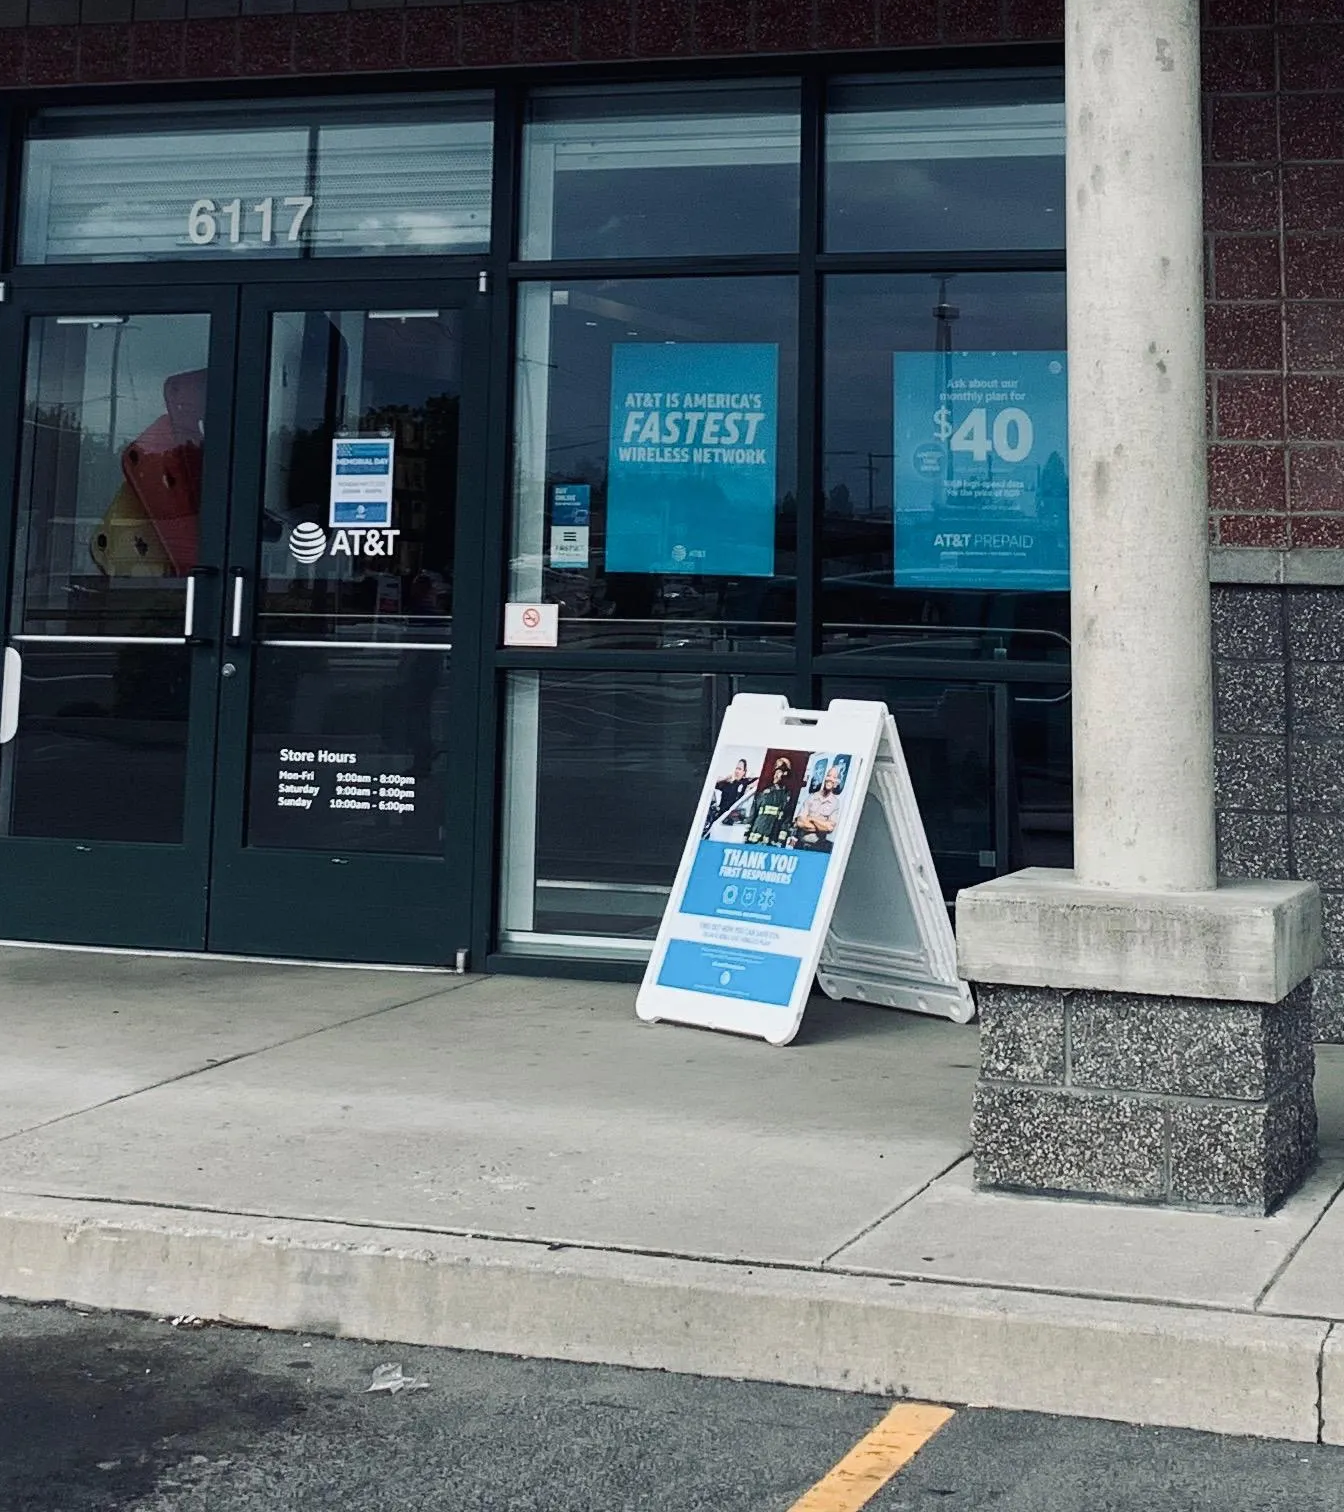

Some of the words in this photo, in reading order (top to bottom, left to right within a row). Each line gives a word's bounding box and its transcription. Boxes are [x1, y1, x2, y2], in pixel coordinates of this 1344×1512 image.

[188, 196, 313, 244] 6117
[946, 379, 967, 389] Ask
[969, 379, 998, 389] about
[625, 392, 663, 408] AT&T
[666, 392, 680, 408] IS
[683, 392, 762, 409] AMERICA'S
[939, 392, 983, 403] monthly
[985, 392, 1009, 403] plan
[1010, 391, 1027, 401] for
[623, 410, 765, 445] FASTEST
[933, 405, 1034, 462] $40
[619, 446, 689, 463] WIRELESS
[693, 447, 767, 465] NETWORK
[330, 529, 401, 556] AT&T
[933, 534, 973, 547] AT&T
[974, 534, 1034, 548] PREPAID
[280, 749, 314, 762] Store
[318, 750, 357, 763] Hours
[279, 771, 314, 780] Mon-Fri
[336, 773, 371, 783] 9:00am
[278, 783, 320, 796] Saturday
[278, 796, 312, 809] Sunday
[722, 848, 769, 871] THANK
[769, 853, 798, 873] YOU
[719, 865, 741, 877] FIRST
[741, 868, 792, 885] RESPONDERS
